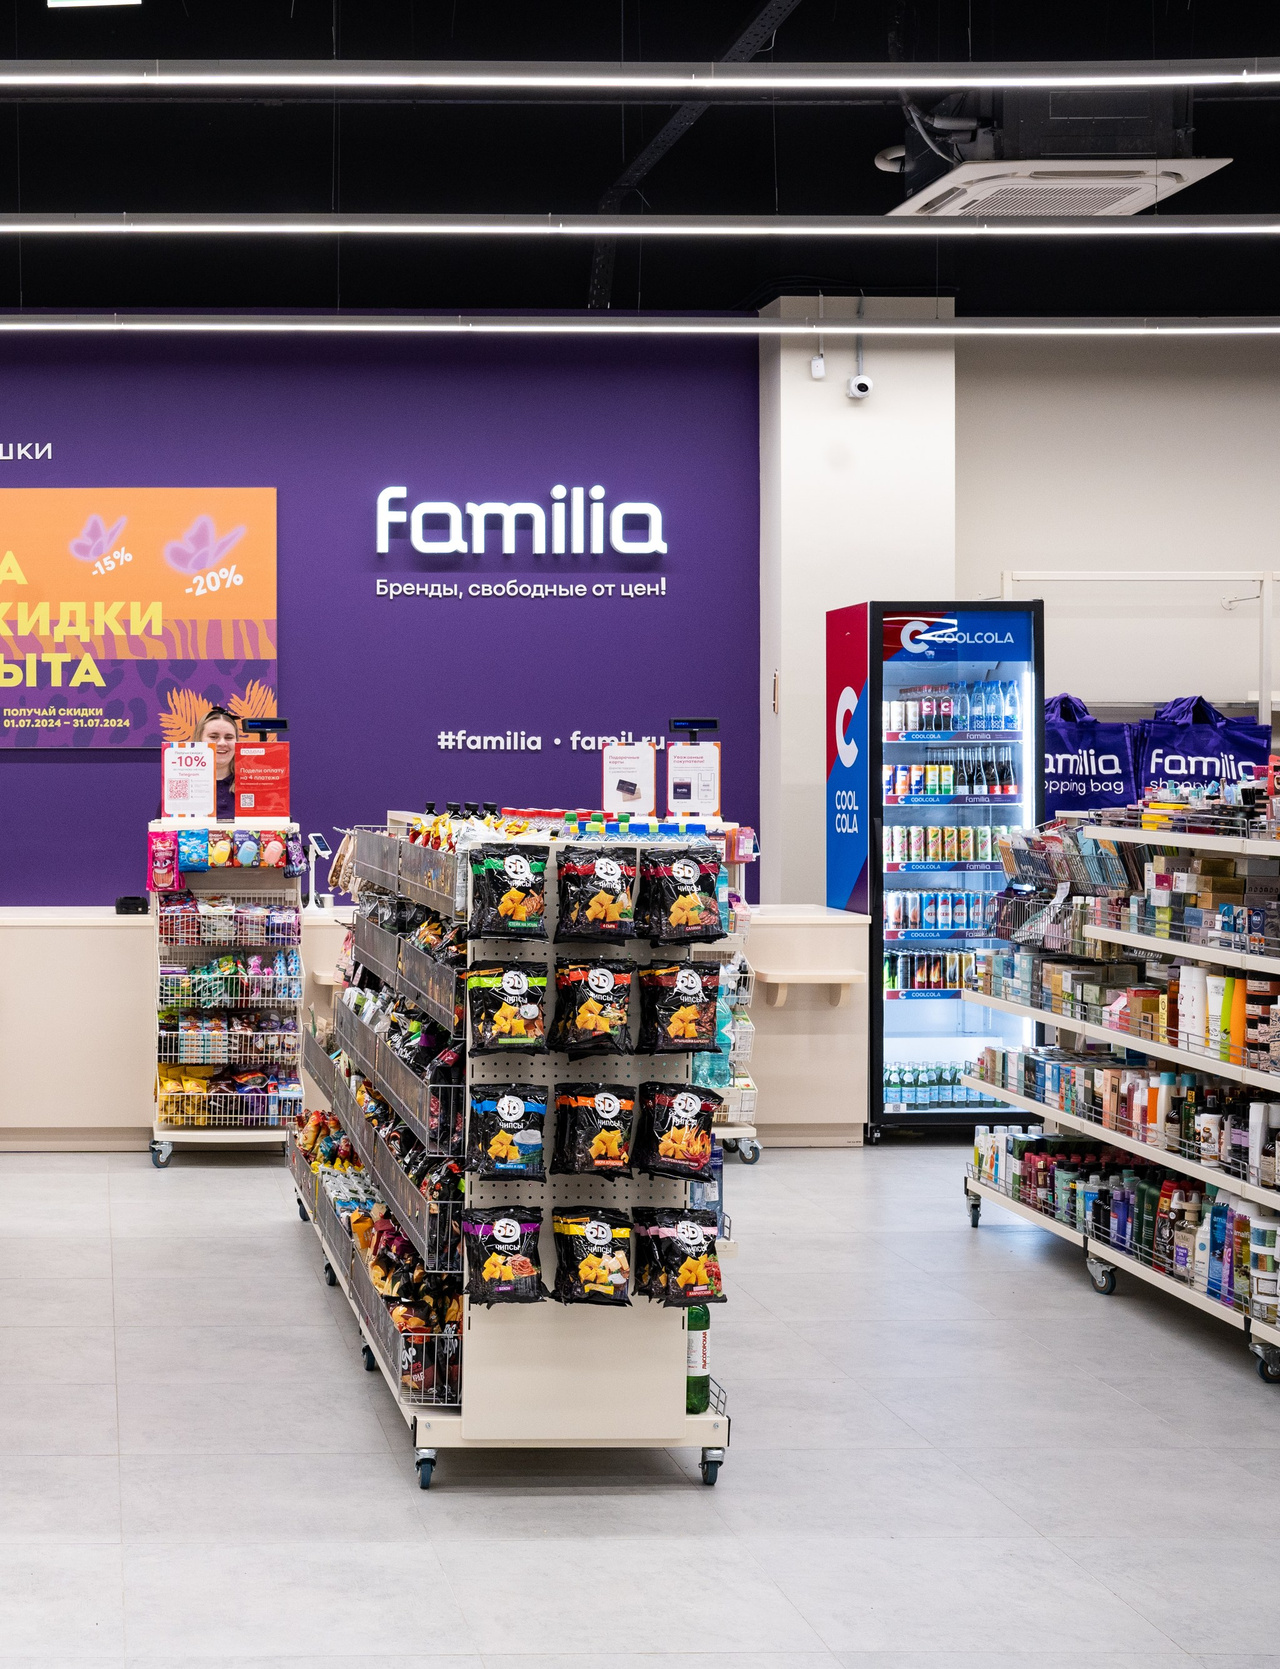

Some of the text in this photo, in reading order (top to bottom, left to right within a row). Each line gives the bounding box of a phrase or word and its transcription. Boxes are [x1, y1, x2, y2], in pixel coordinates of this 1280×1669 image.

[375, 484, 668, 555] familia
[91, 546, 133, 577] -15%
[184, 564, 244, 597] -20%
[376, 576, 667, 599] Бренды, свободные от цен!
[934, 632, 1015, 644] COOLCOLA
[3, 706, 103, 718] ПОЛУЧАЙ СКИДКИ
[3, 719, 61, 728] 01.07.2024
[73, 718, 131, 728] 31.07.2024
[437, 730, 666, 750] #familia familru
[966, 732, 991, 740] familia
[171, 756, 207, 767] -10%
[1045, 749, 1122, 776] amilia
[1090, 778, 1124, 796] bag
[835, 790, 859, 811] COOL
[965, 796, 990, 804] familia
[835, 814, 859, 834] COLA
